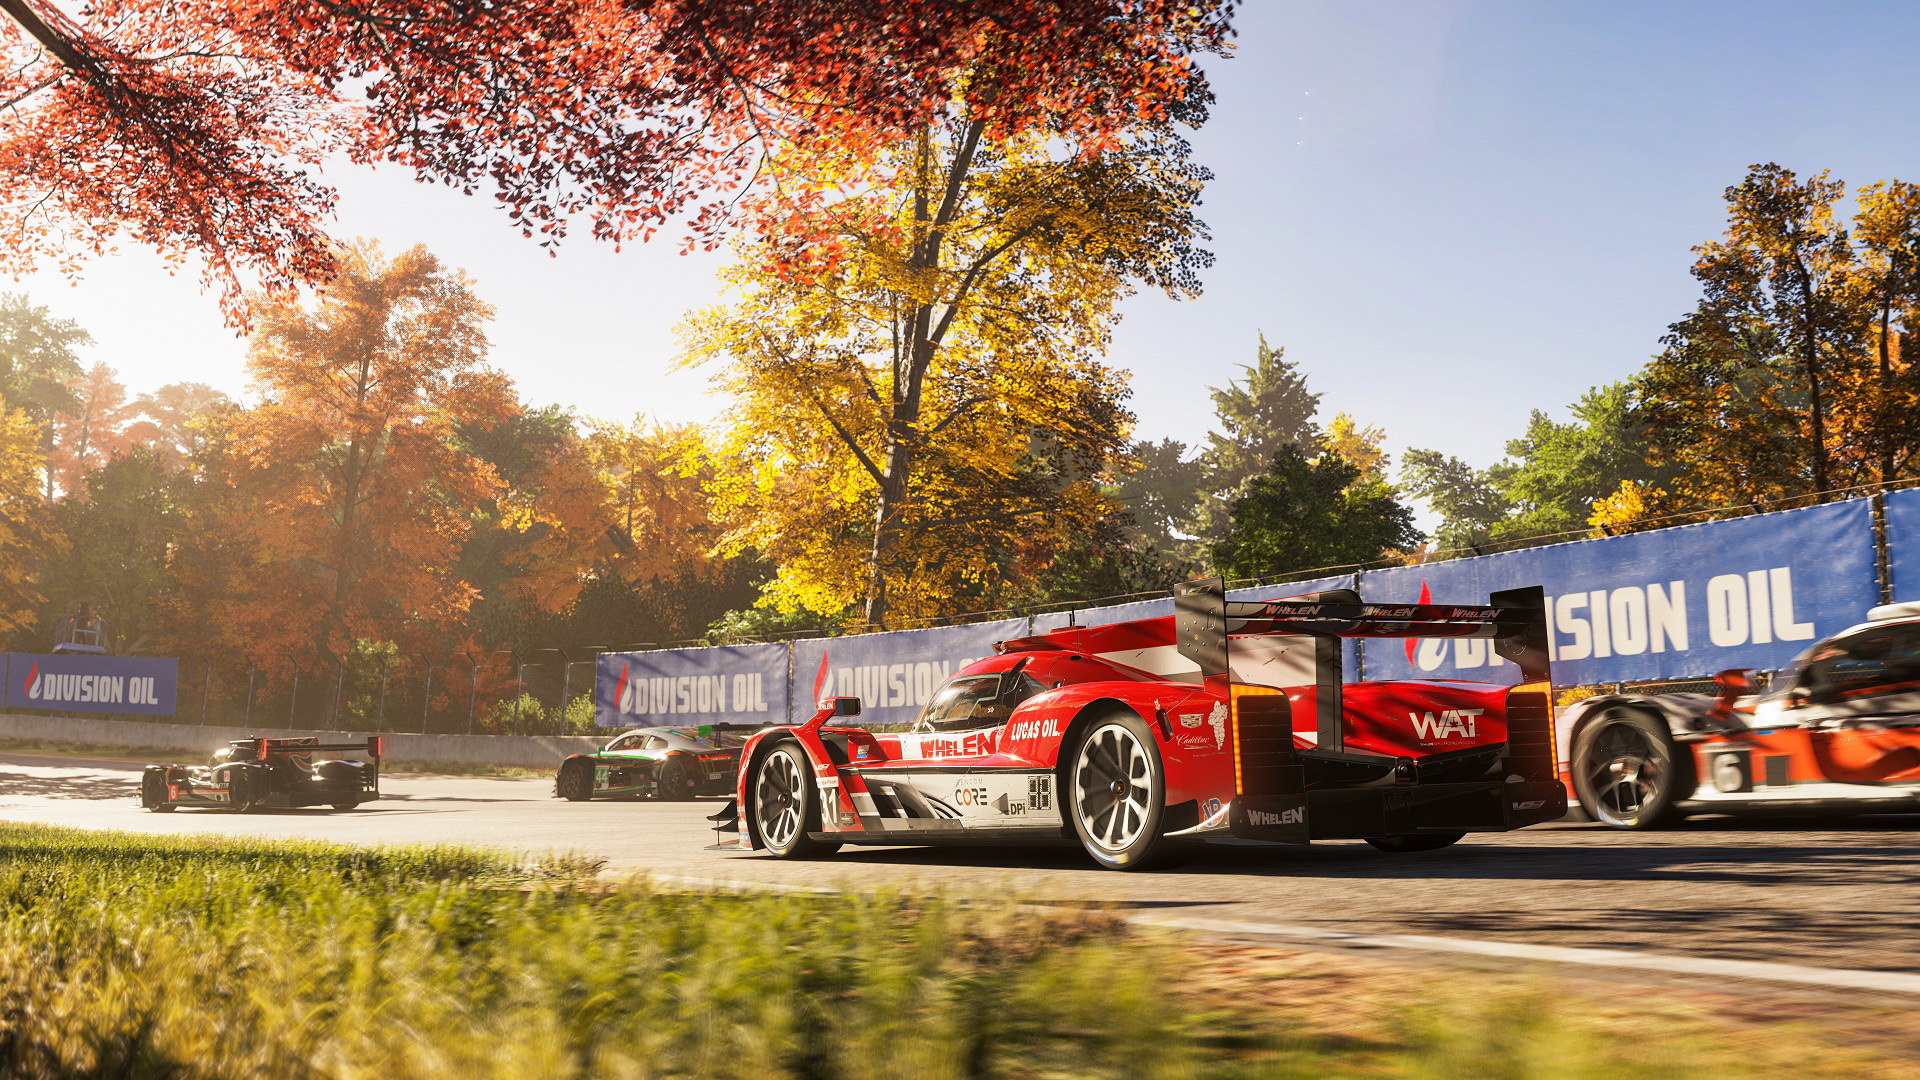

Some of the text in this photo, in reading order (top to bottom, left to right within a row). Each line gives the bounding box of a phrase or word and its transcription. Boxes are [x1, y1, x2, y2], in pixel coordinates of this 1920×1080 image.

[1266, 604, 1322, 615] WHELEN
[1364, 606, 1417, 618] WHELEN
[1452, 607, 1502, 619] WHELEN
[1706, 567, 1815, 647] OIL
[43, 673, 159, 705] DIVISION OIL
[635, 672, 768, 715] DIVISION OIL
[1011, 720, 1040, 741] LUCAS
[1408, 708, 1485, 740] WAT
[920, 730, 998, 759] WHELEN
[1175, 733, 1210, 746] Cadillac
[595, 770, 608, 784] 44
[1713, 753, 1744, 793] 6
[171, 785, 177, 799] 6
[955, 787, 988, 806] CORE
[1010, 802, 1026, 815] DPi
[1247, 807, 1304, 826] WHELEN
